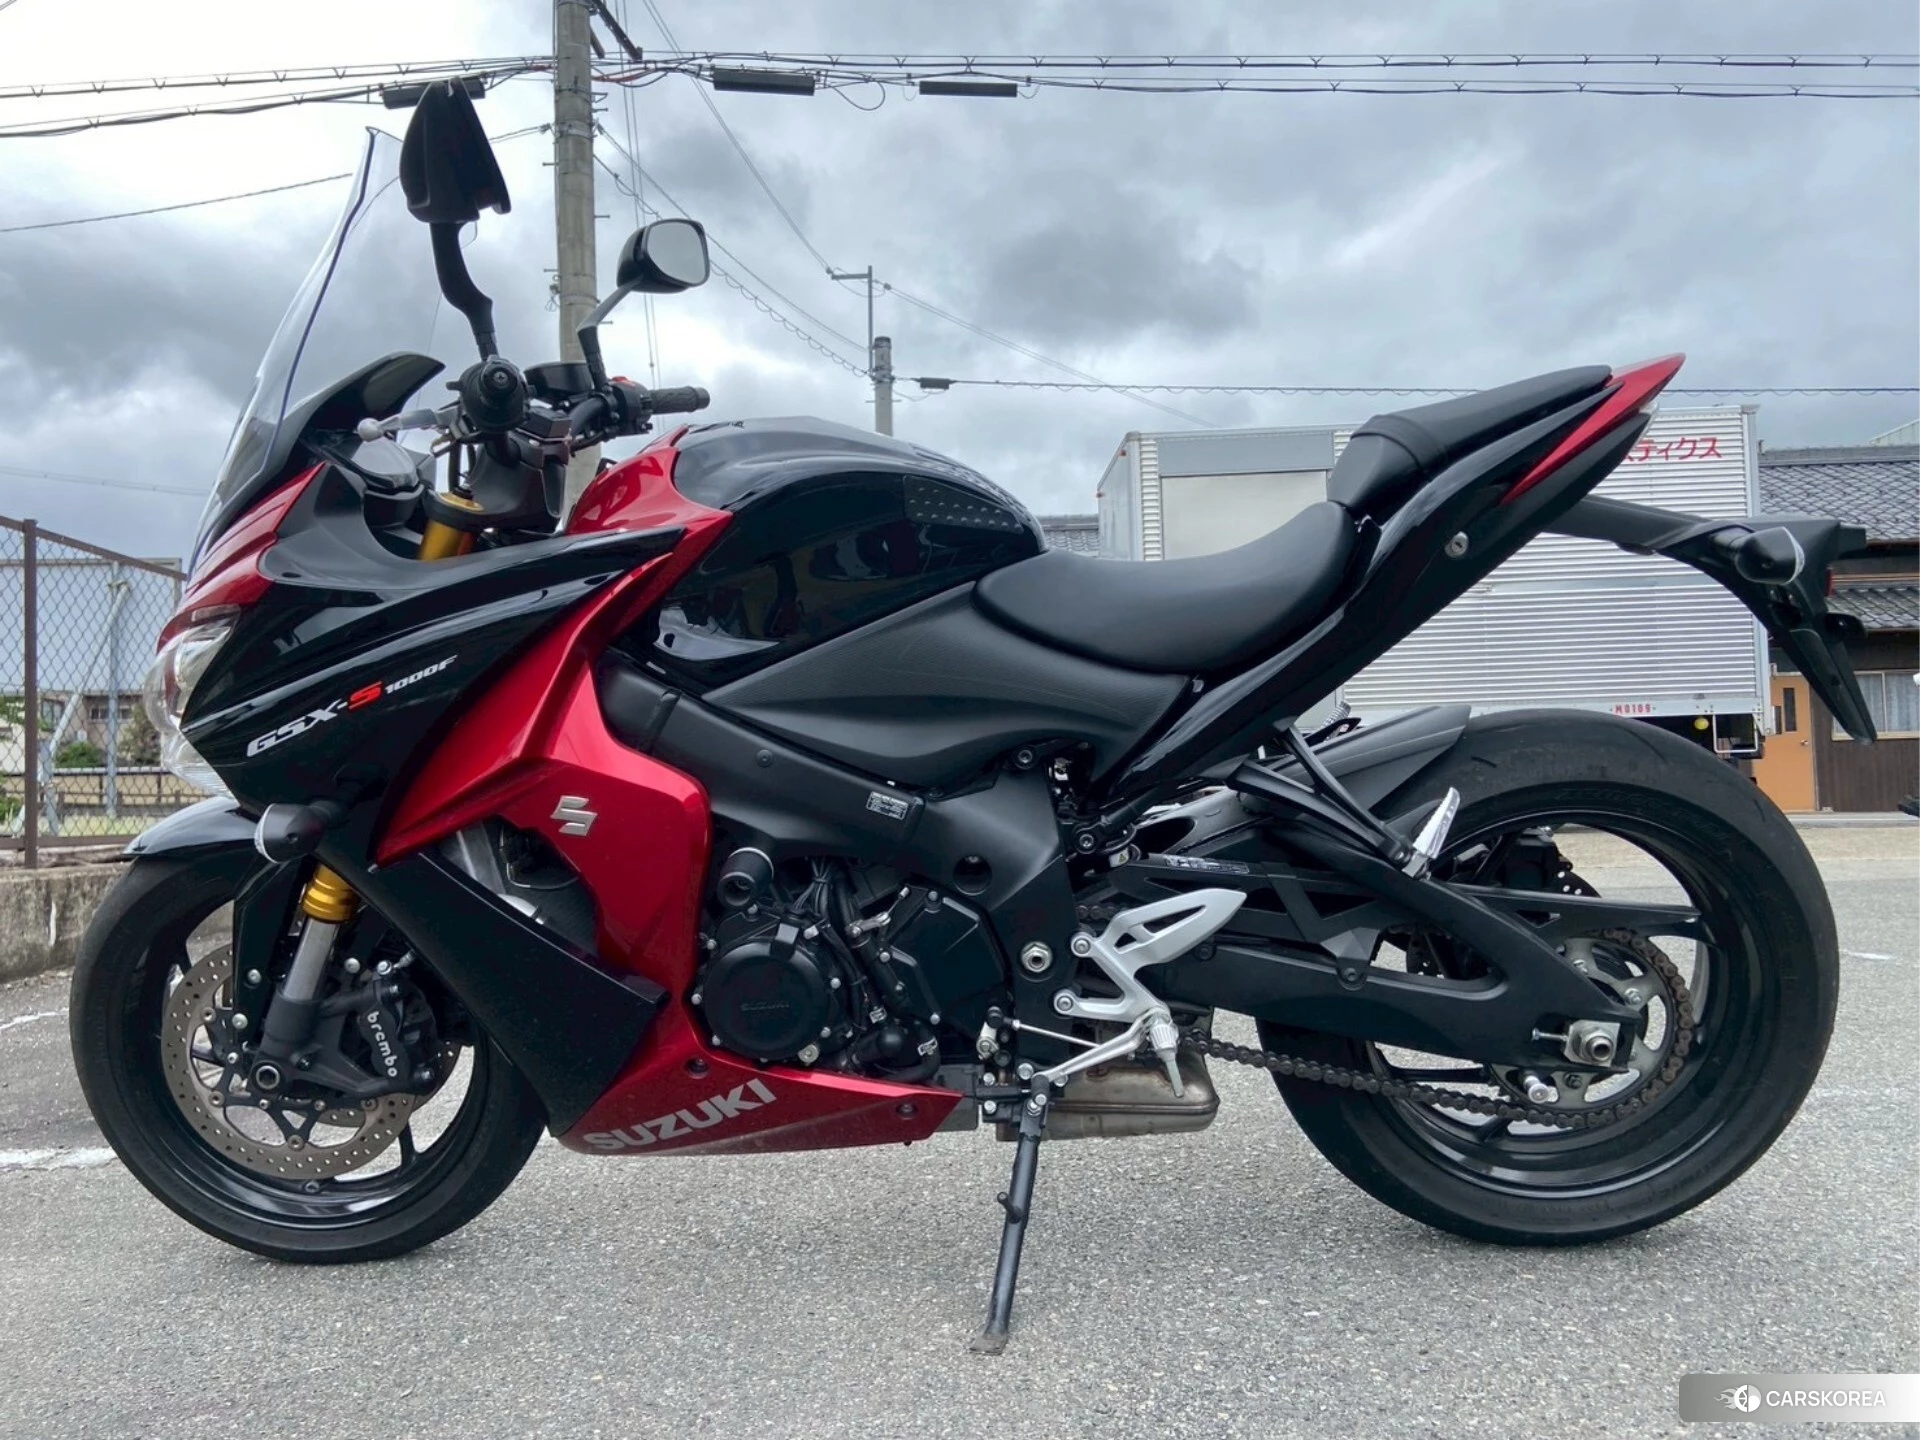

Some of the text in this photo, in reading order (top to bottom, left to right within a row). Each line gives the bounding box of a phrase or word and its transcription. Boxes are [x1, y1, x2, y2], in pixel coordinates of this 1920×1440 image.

[1627, 437, 1722, 462] ティクス
[384, 654, 458, 694] 1000F
[367, 1011, 397, 1077] brembo
[583, 1078, 777, 1150] SUZUKI
